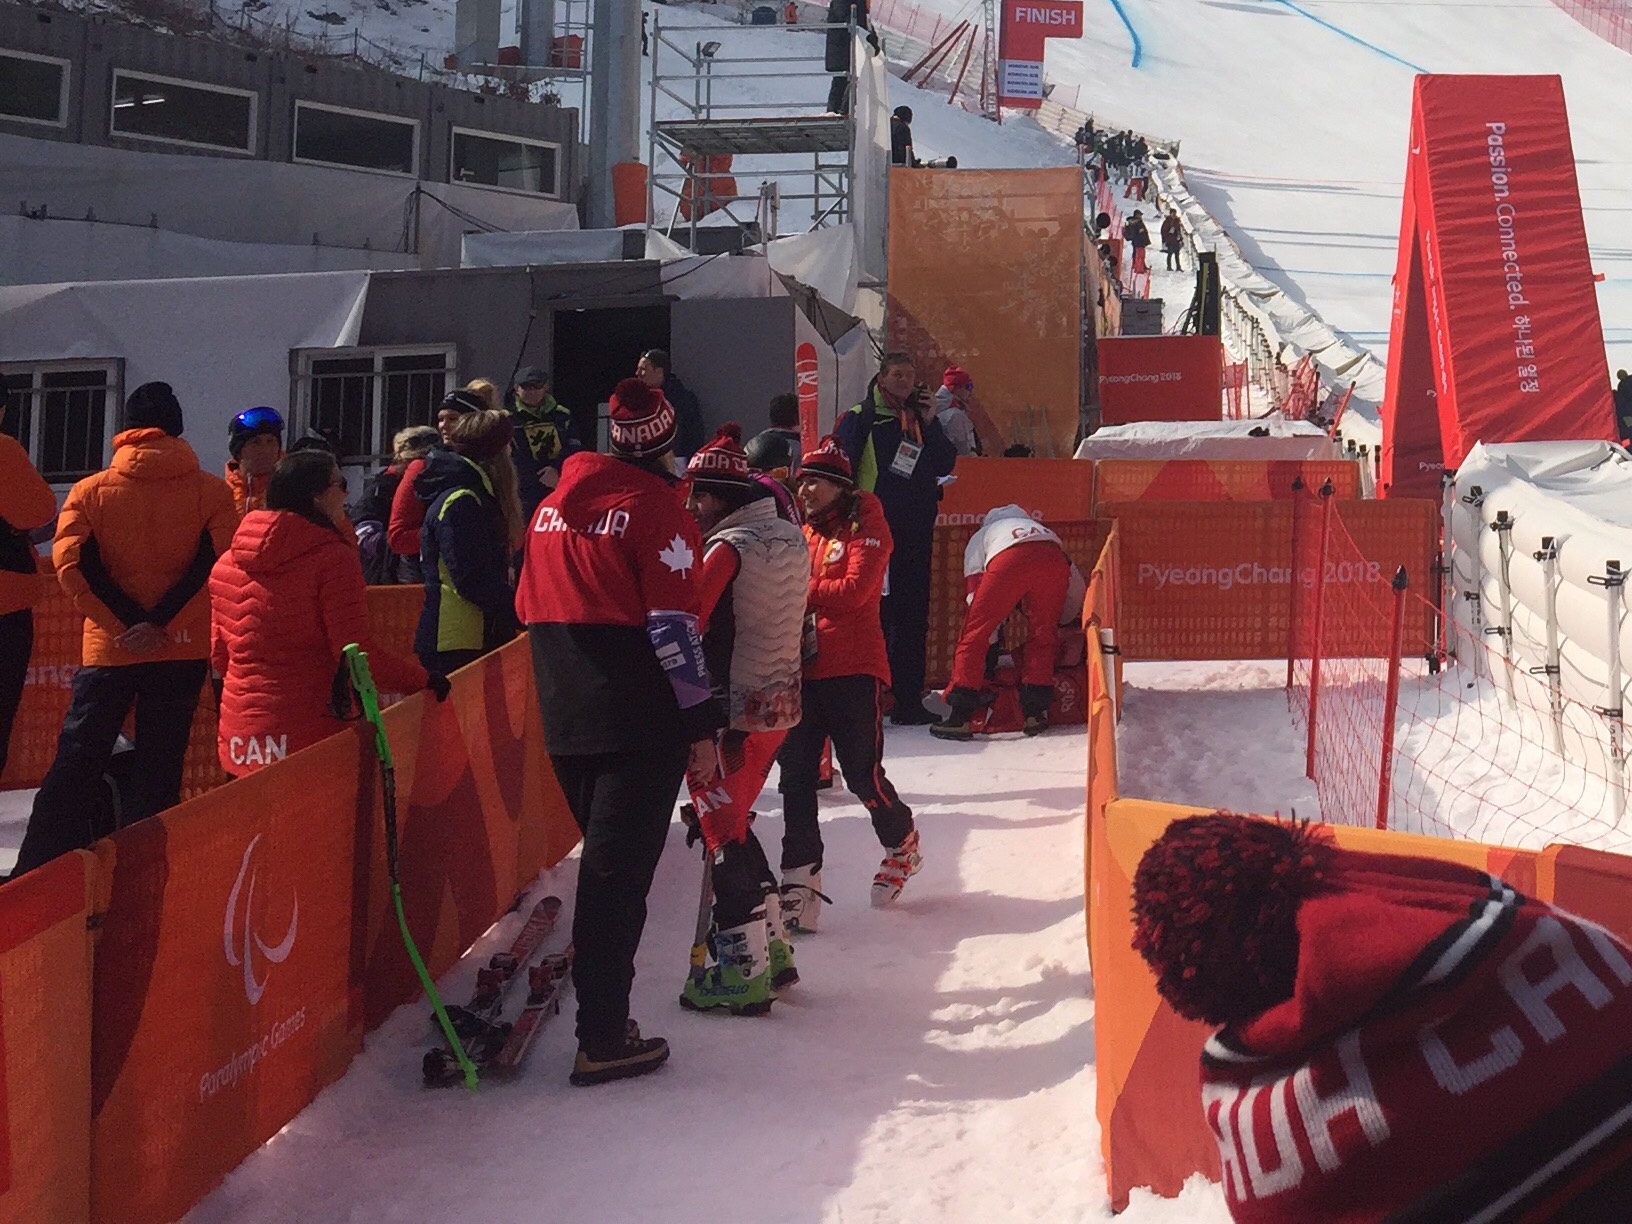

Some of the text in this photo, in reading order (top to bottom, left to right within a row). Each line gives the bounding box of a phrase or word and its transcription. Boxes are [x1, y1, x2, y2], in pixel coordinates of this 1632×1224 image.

[1015, 7, 1076, 25] FINISH
[1486, 122, 1530, 310] Passion. Connected.
[1098, 371, 1182, 385] PyeongChang 2018
[533, 506, 631, 539] CADA
[1323, 560, 1382, 584] 2018
[228, 733, 288, 766] CAN
[199, 1006, 306, 1104] Paralympic Games
